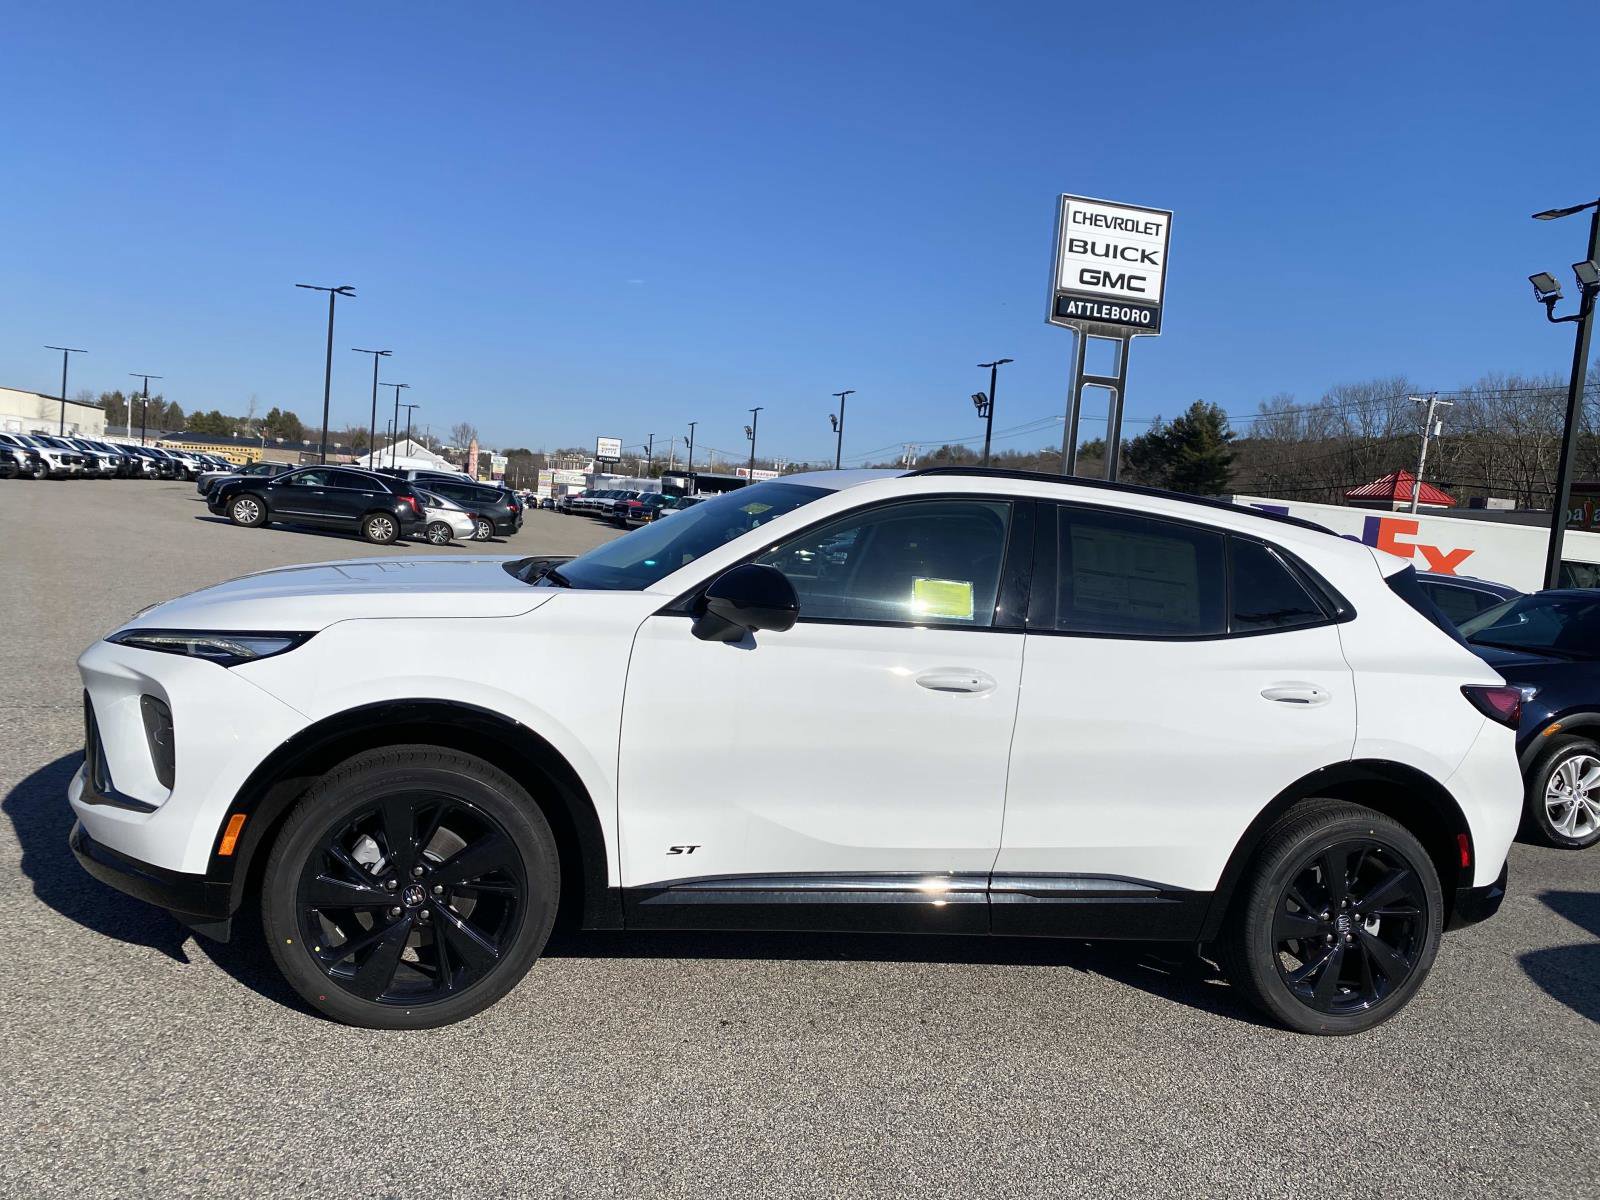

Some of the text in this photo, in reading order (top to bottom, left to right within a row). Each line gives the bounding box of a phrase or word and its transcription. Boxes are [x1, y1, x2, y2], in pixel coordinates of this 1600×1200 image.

[1072, 210, 1163, 236] CHEVROLET
[1068, 238, 1160, 266] BUICK
[1079, 268, 1147, 293] GMC
[1067, 301, 1151, 324] ATTLEBORO
[666, 845, 702, 856] ST
